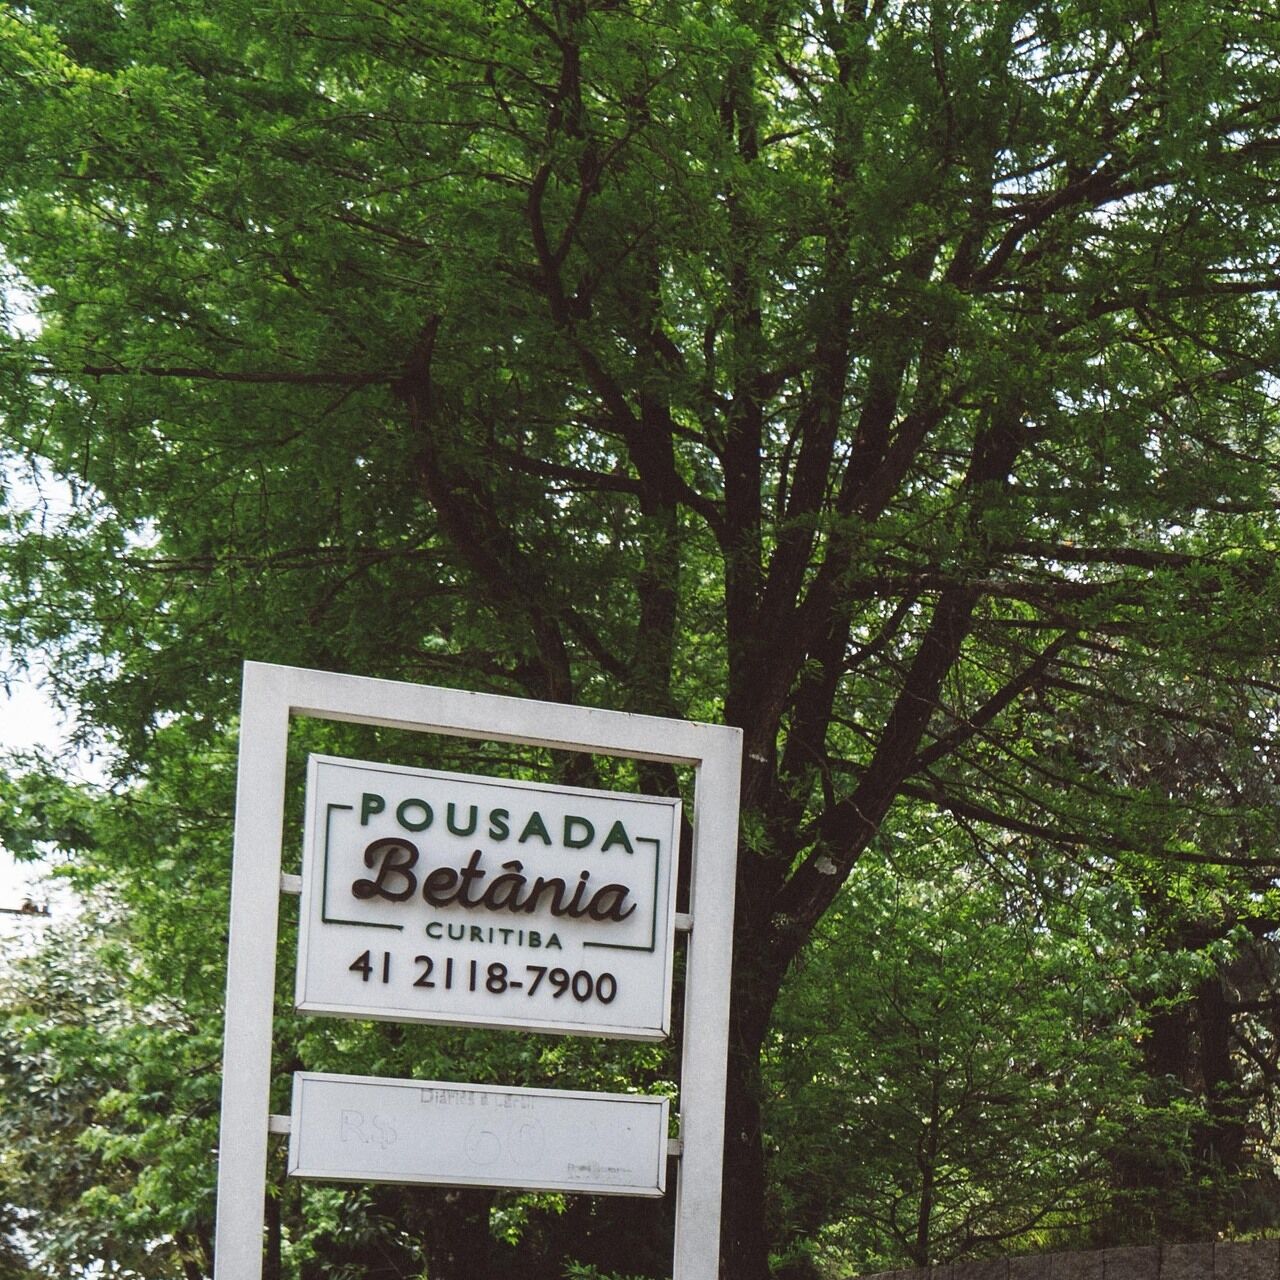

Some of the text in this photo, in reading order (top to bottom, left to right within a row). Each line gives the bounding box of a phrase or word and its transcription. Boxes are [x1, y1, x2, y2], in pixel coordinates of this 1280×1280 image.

[361, 792, 634, 855] POUSADA
[351, 836, 637, 923] Betânia
[425, 921, 563, 950] CURITIBA
[348, 949, 618, 1004] 41 2118-7900
